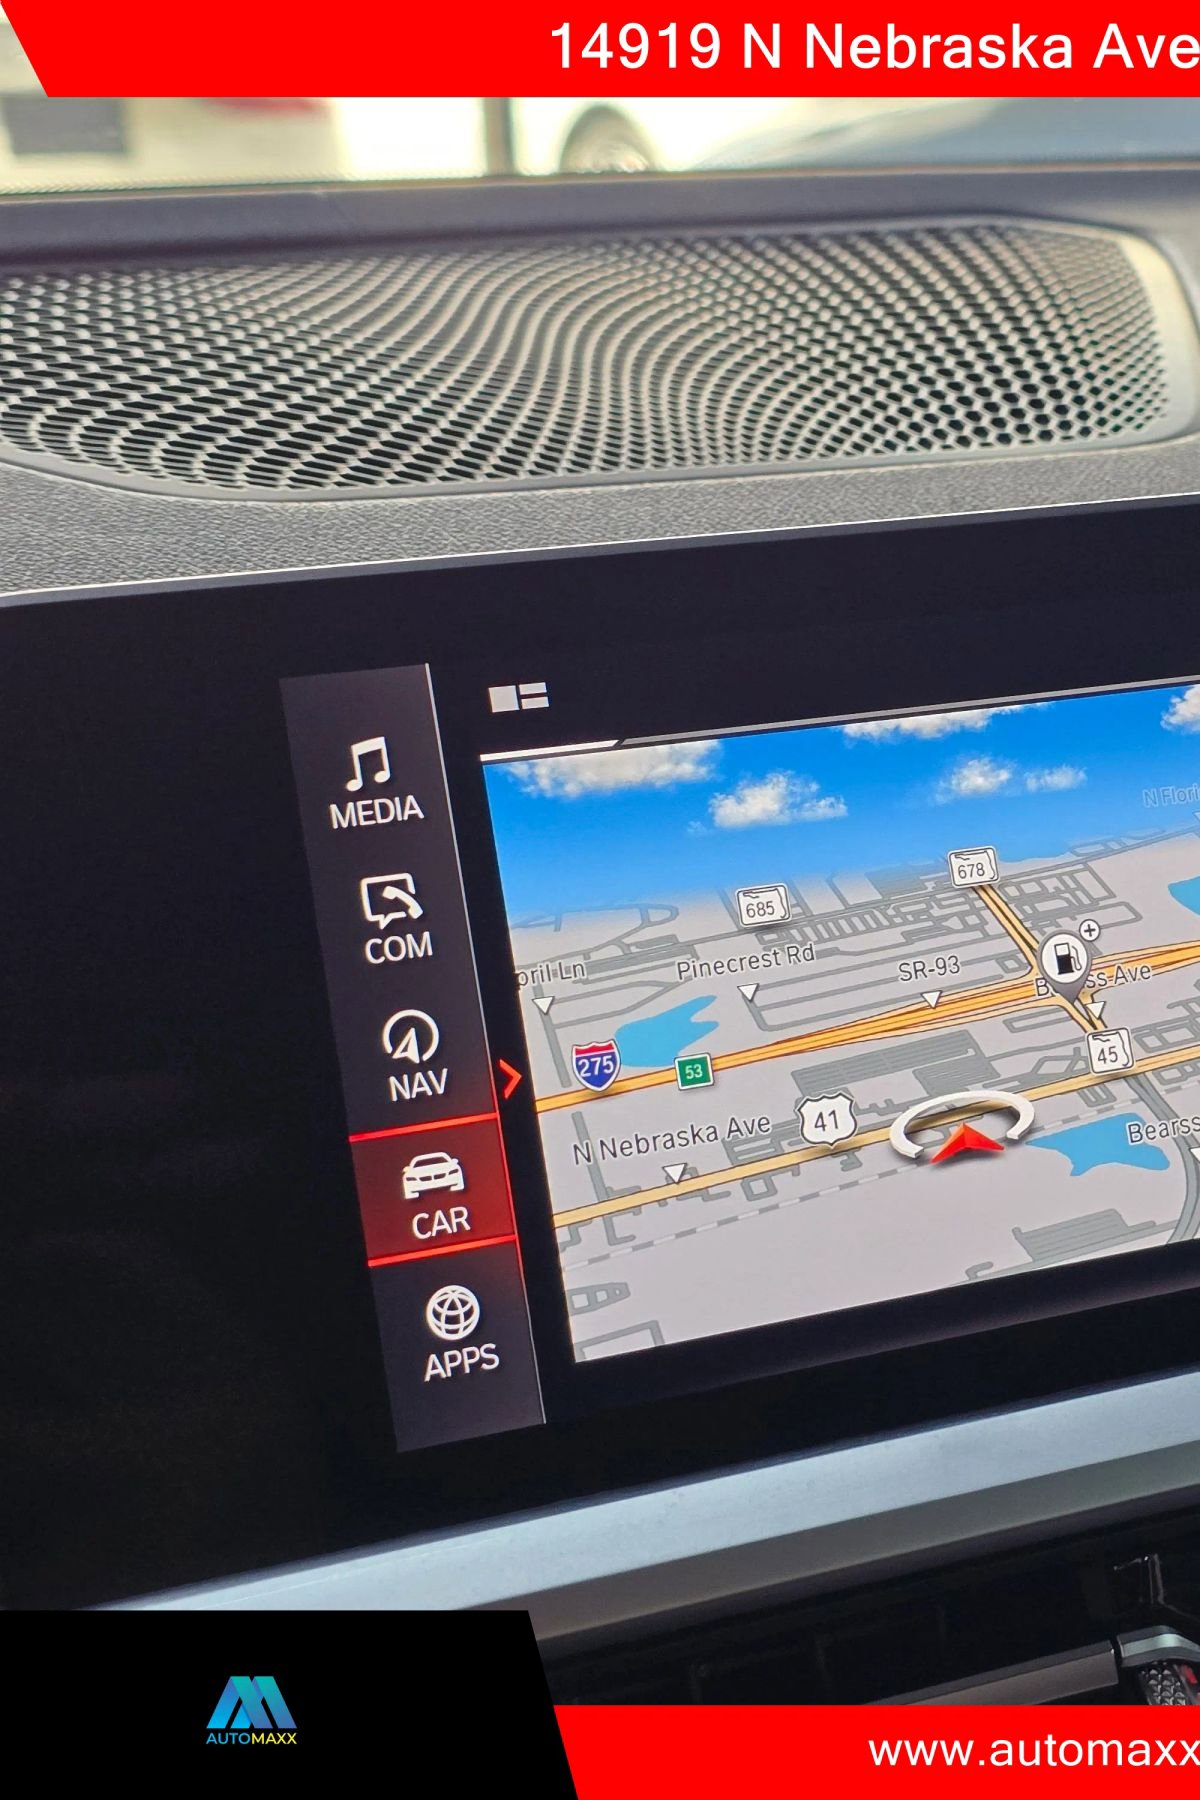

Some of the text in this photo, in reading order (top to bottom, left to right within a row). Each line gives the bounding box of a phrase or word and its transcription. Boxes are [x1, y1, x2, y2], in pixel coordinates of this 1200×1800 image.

[1143, 789, 1158, 807] N
[329, 795, 424, 829] MEDIA
[957, 863, 986, 880] 678
[746, 901, 776, 917] 685
[364, 931, 433, 964] COM
[558, 961, 585, 980] Ln
[676, 943, 816, 981] Pinecrest Rd
[898, 955, 961, 982] SR-93
[1114, 964, 1152, 985] Ave
[577, 1055, 614, 1077] 275
[1097, 1046, 1118, 1064] 45
[685, 1063, 703, 1079] 53
[388, 1067, 449, 1101] NAV
[812, 1110, 841, 1132] 41
[572, 1113, 771, 1165] N Nebraska Ave
[412, 1206, 471, 1239] CAR
[424, 1343, 500, 1382] APPS
